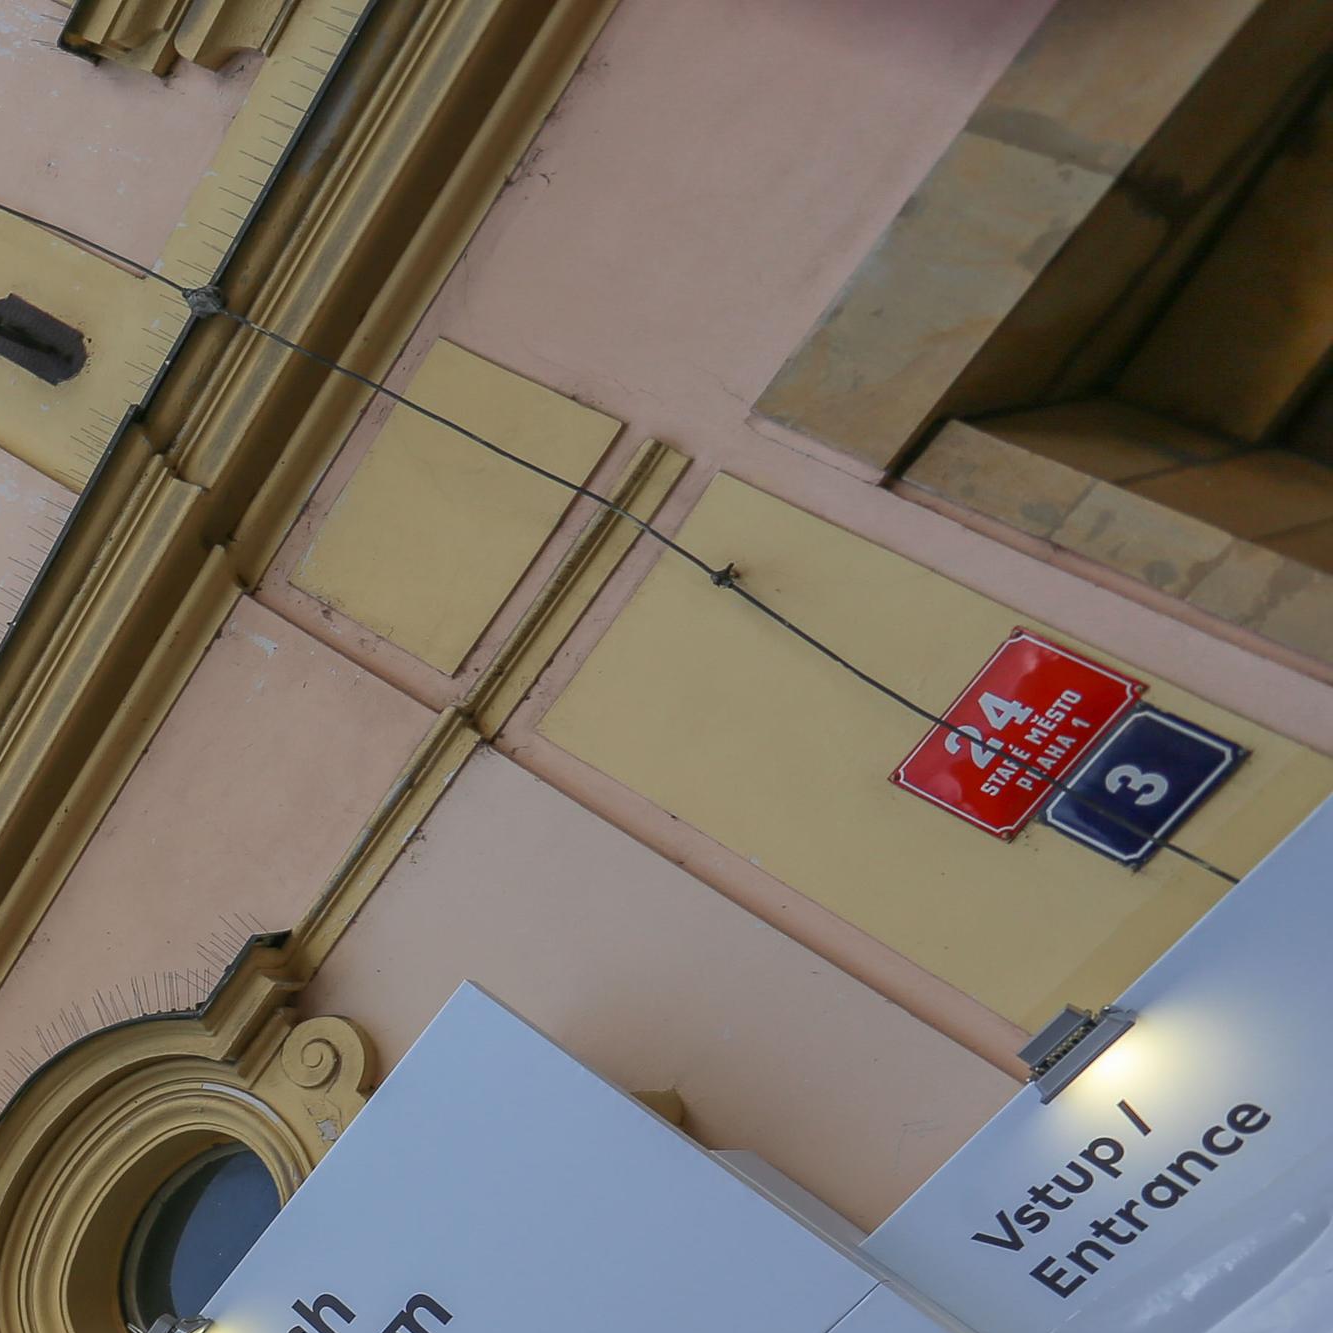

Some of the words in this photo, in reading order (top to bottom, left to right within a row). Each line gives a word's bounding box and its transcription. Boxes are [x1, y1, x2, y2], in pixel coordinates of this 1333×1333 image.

[945, 692, 1034, 769] 24
[1024, 690, 1082, 745] MĚSTO
[1071, 717, 1090, 729] 1
[1105, 764, 1169, 806] 3
[971, 1137, 1125, 1251] Vstup
[1029, 1103, 1271, 1299] Entrance
